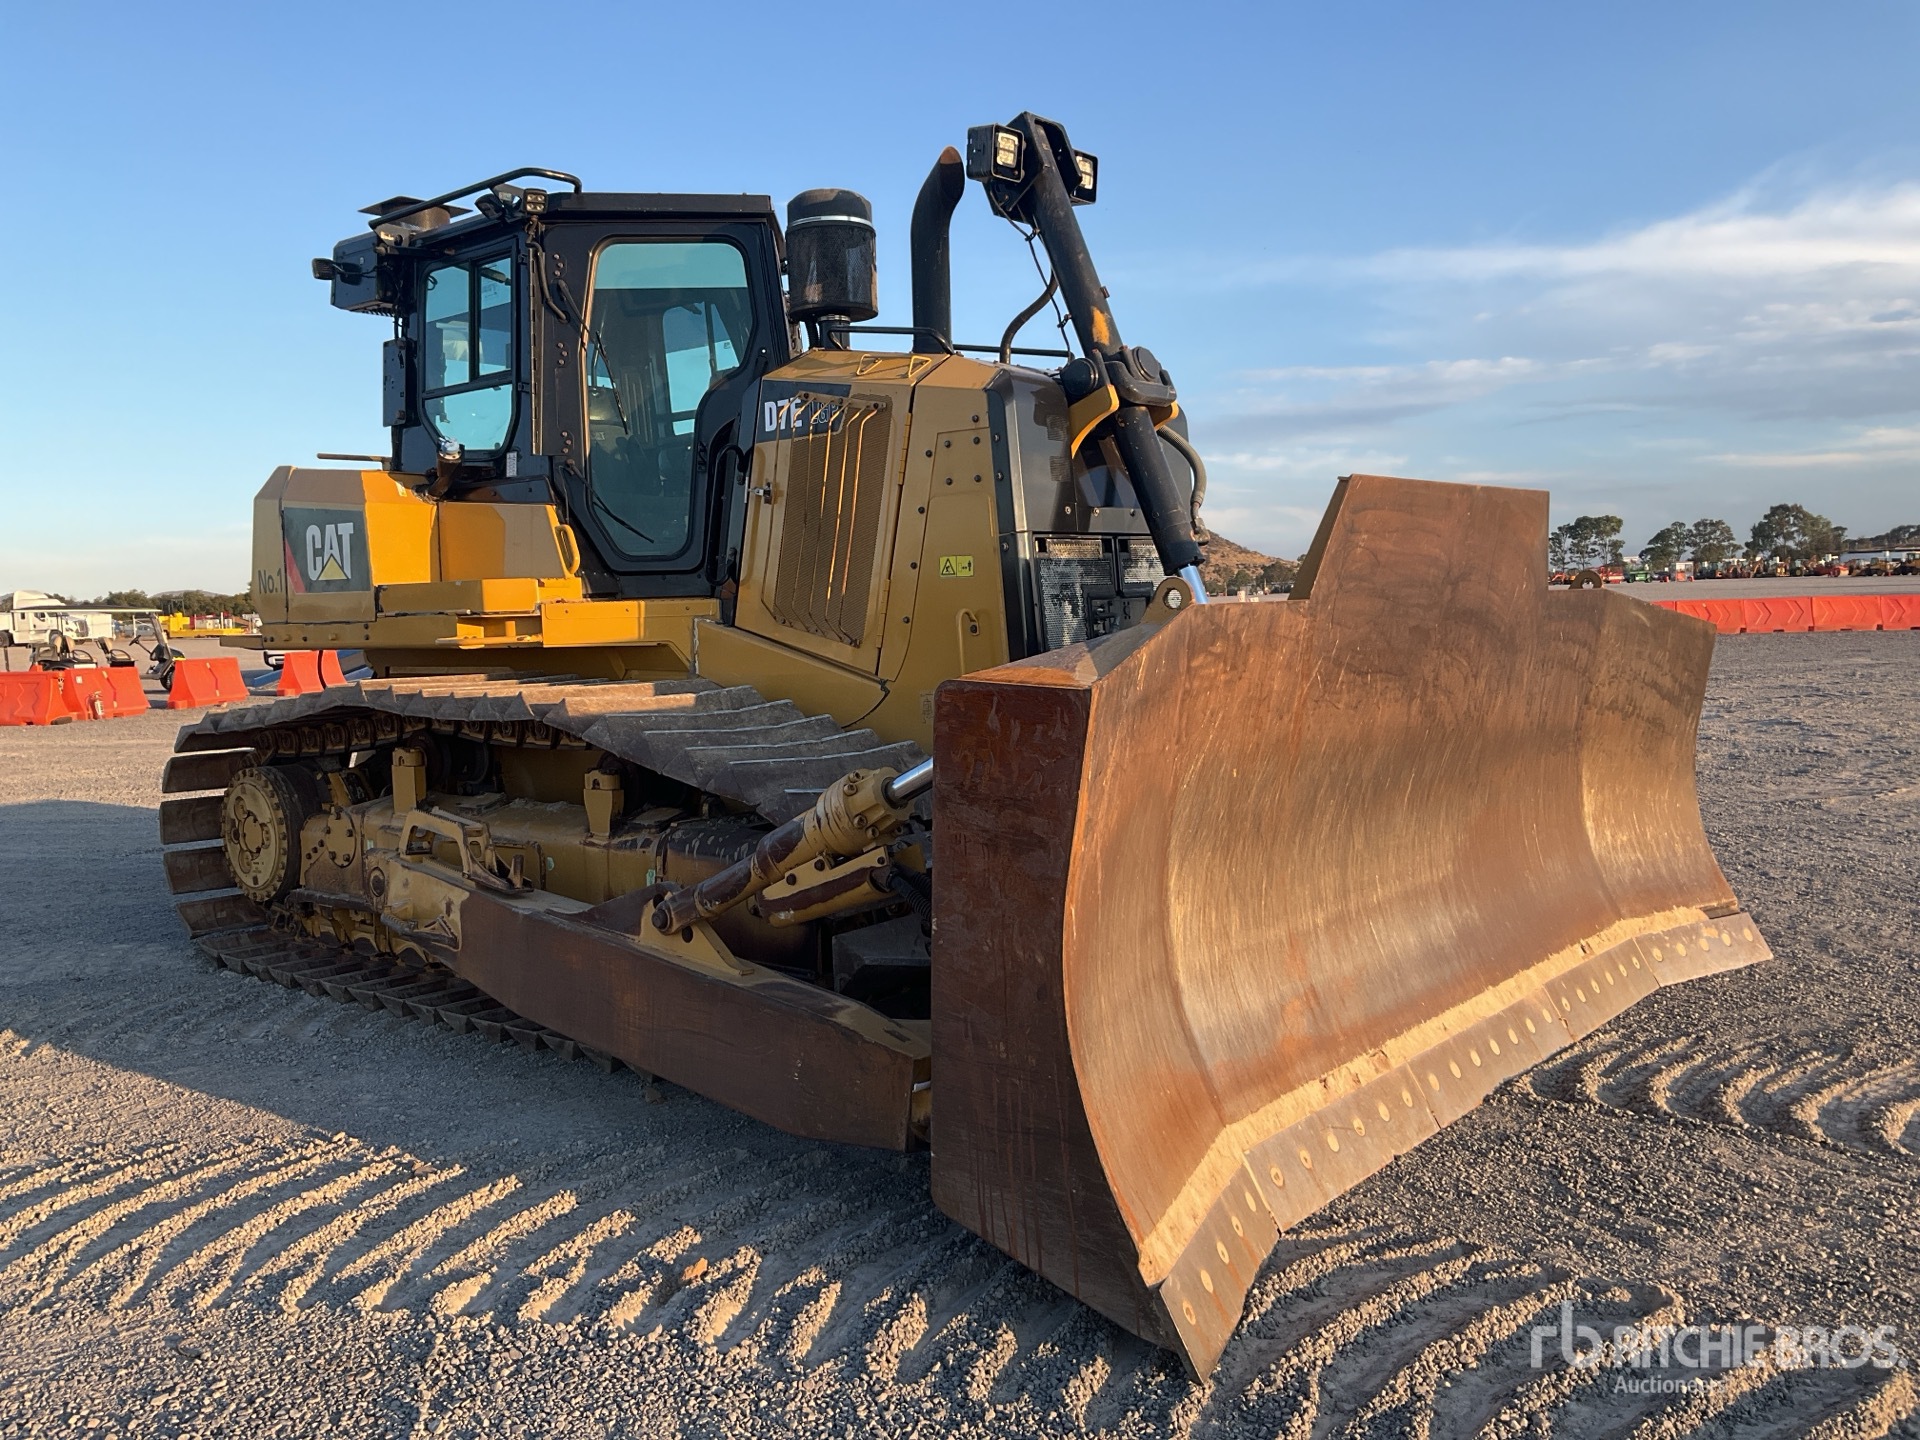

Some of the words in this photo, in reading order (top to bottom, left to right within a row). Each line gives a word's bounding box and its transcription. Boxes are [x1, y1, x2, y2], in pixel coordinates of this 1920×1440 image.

[764, 398, 803, 432] D7E
[306, 522, 354, 581] CAT
[257, 567, 284, 594] No.1
